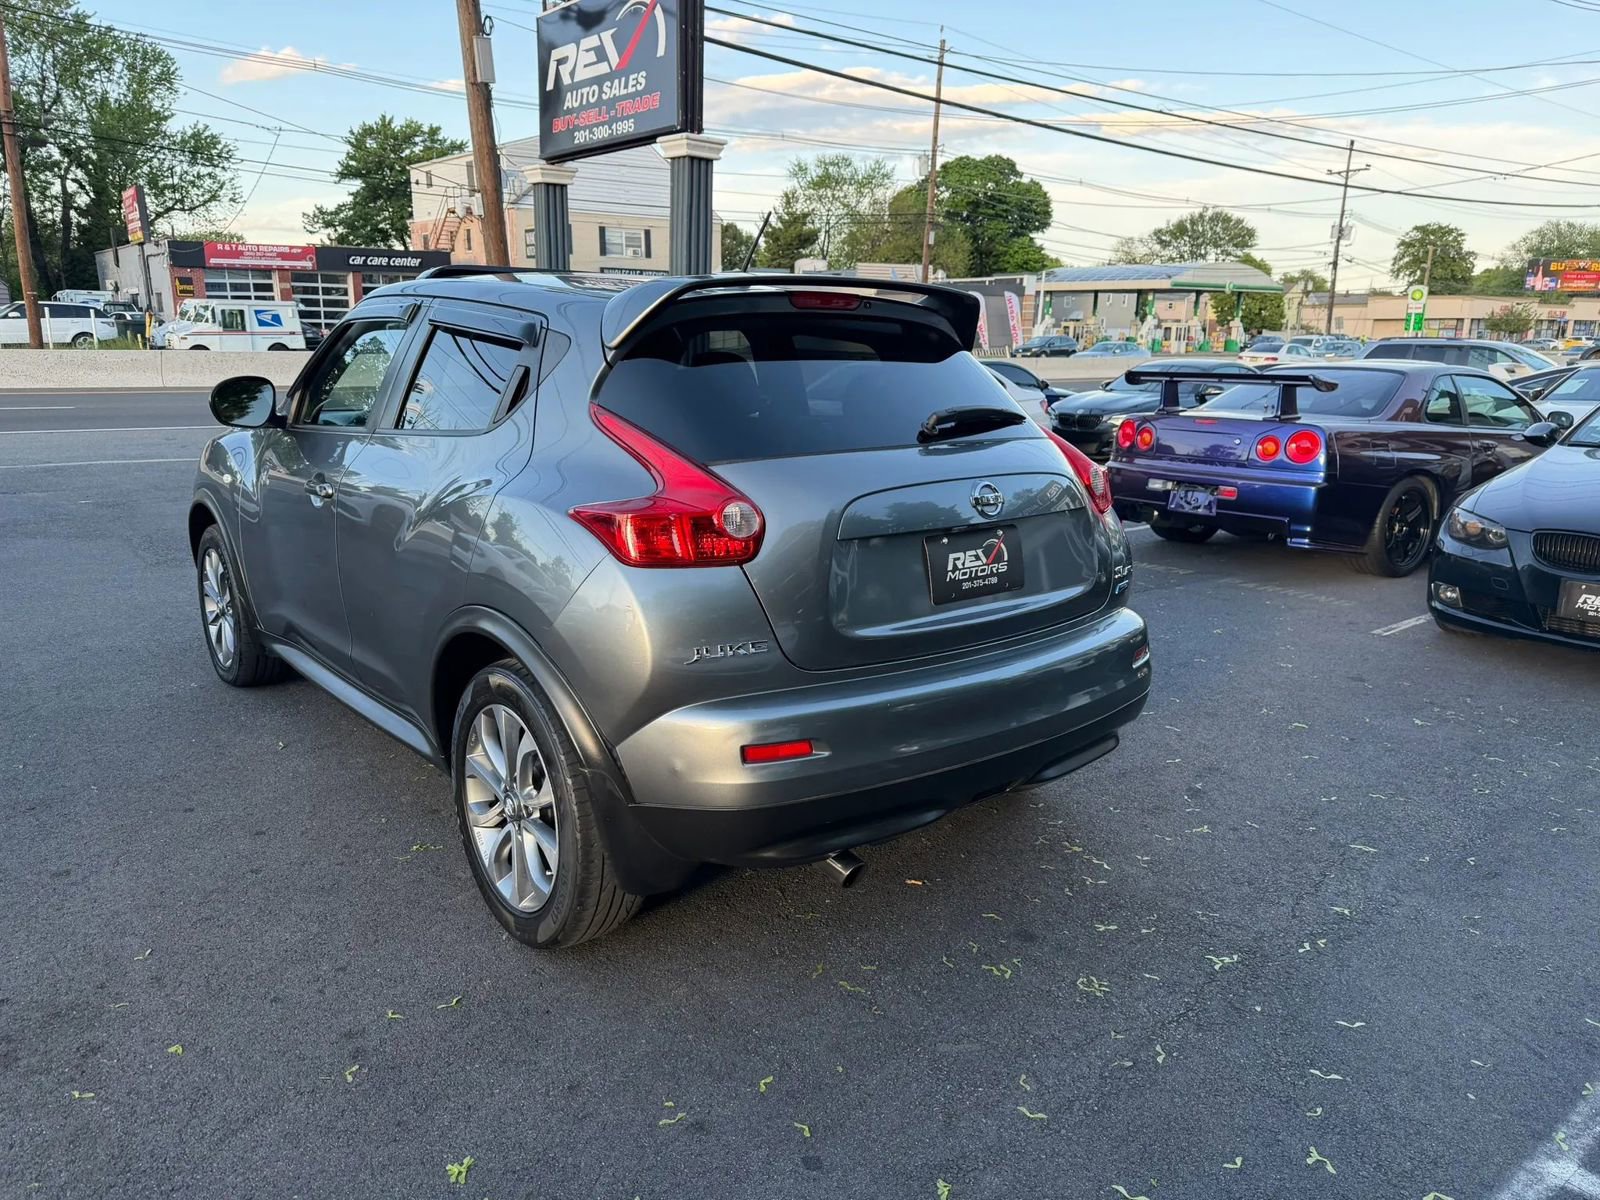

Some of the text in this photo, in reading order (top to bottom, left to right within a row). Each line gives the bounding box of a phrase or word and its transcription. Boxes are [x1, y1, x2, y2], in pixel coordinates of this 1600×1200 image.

[563, 71, 647, 110] AUTO SALES
[616, 92, 661, 117] TRADE
[573, 119, 635, 144] 201-300-1995
[349, 256, 422, 266] car care center
[946, 562, 1008, 582] MOTORS
[962, 576, 998, 590] 201-375-4789
[683, 640, 768, 665] JUKE
